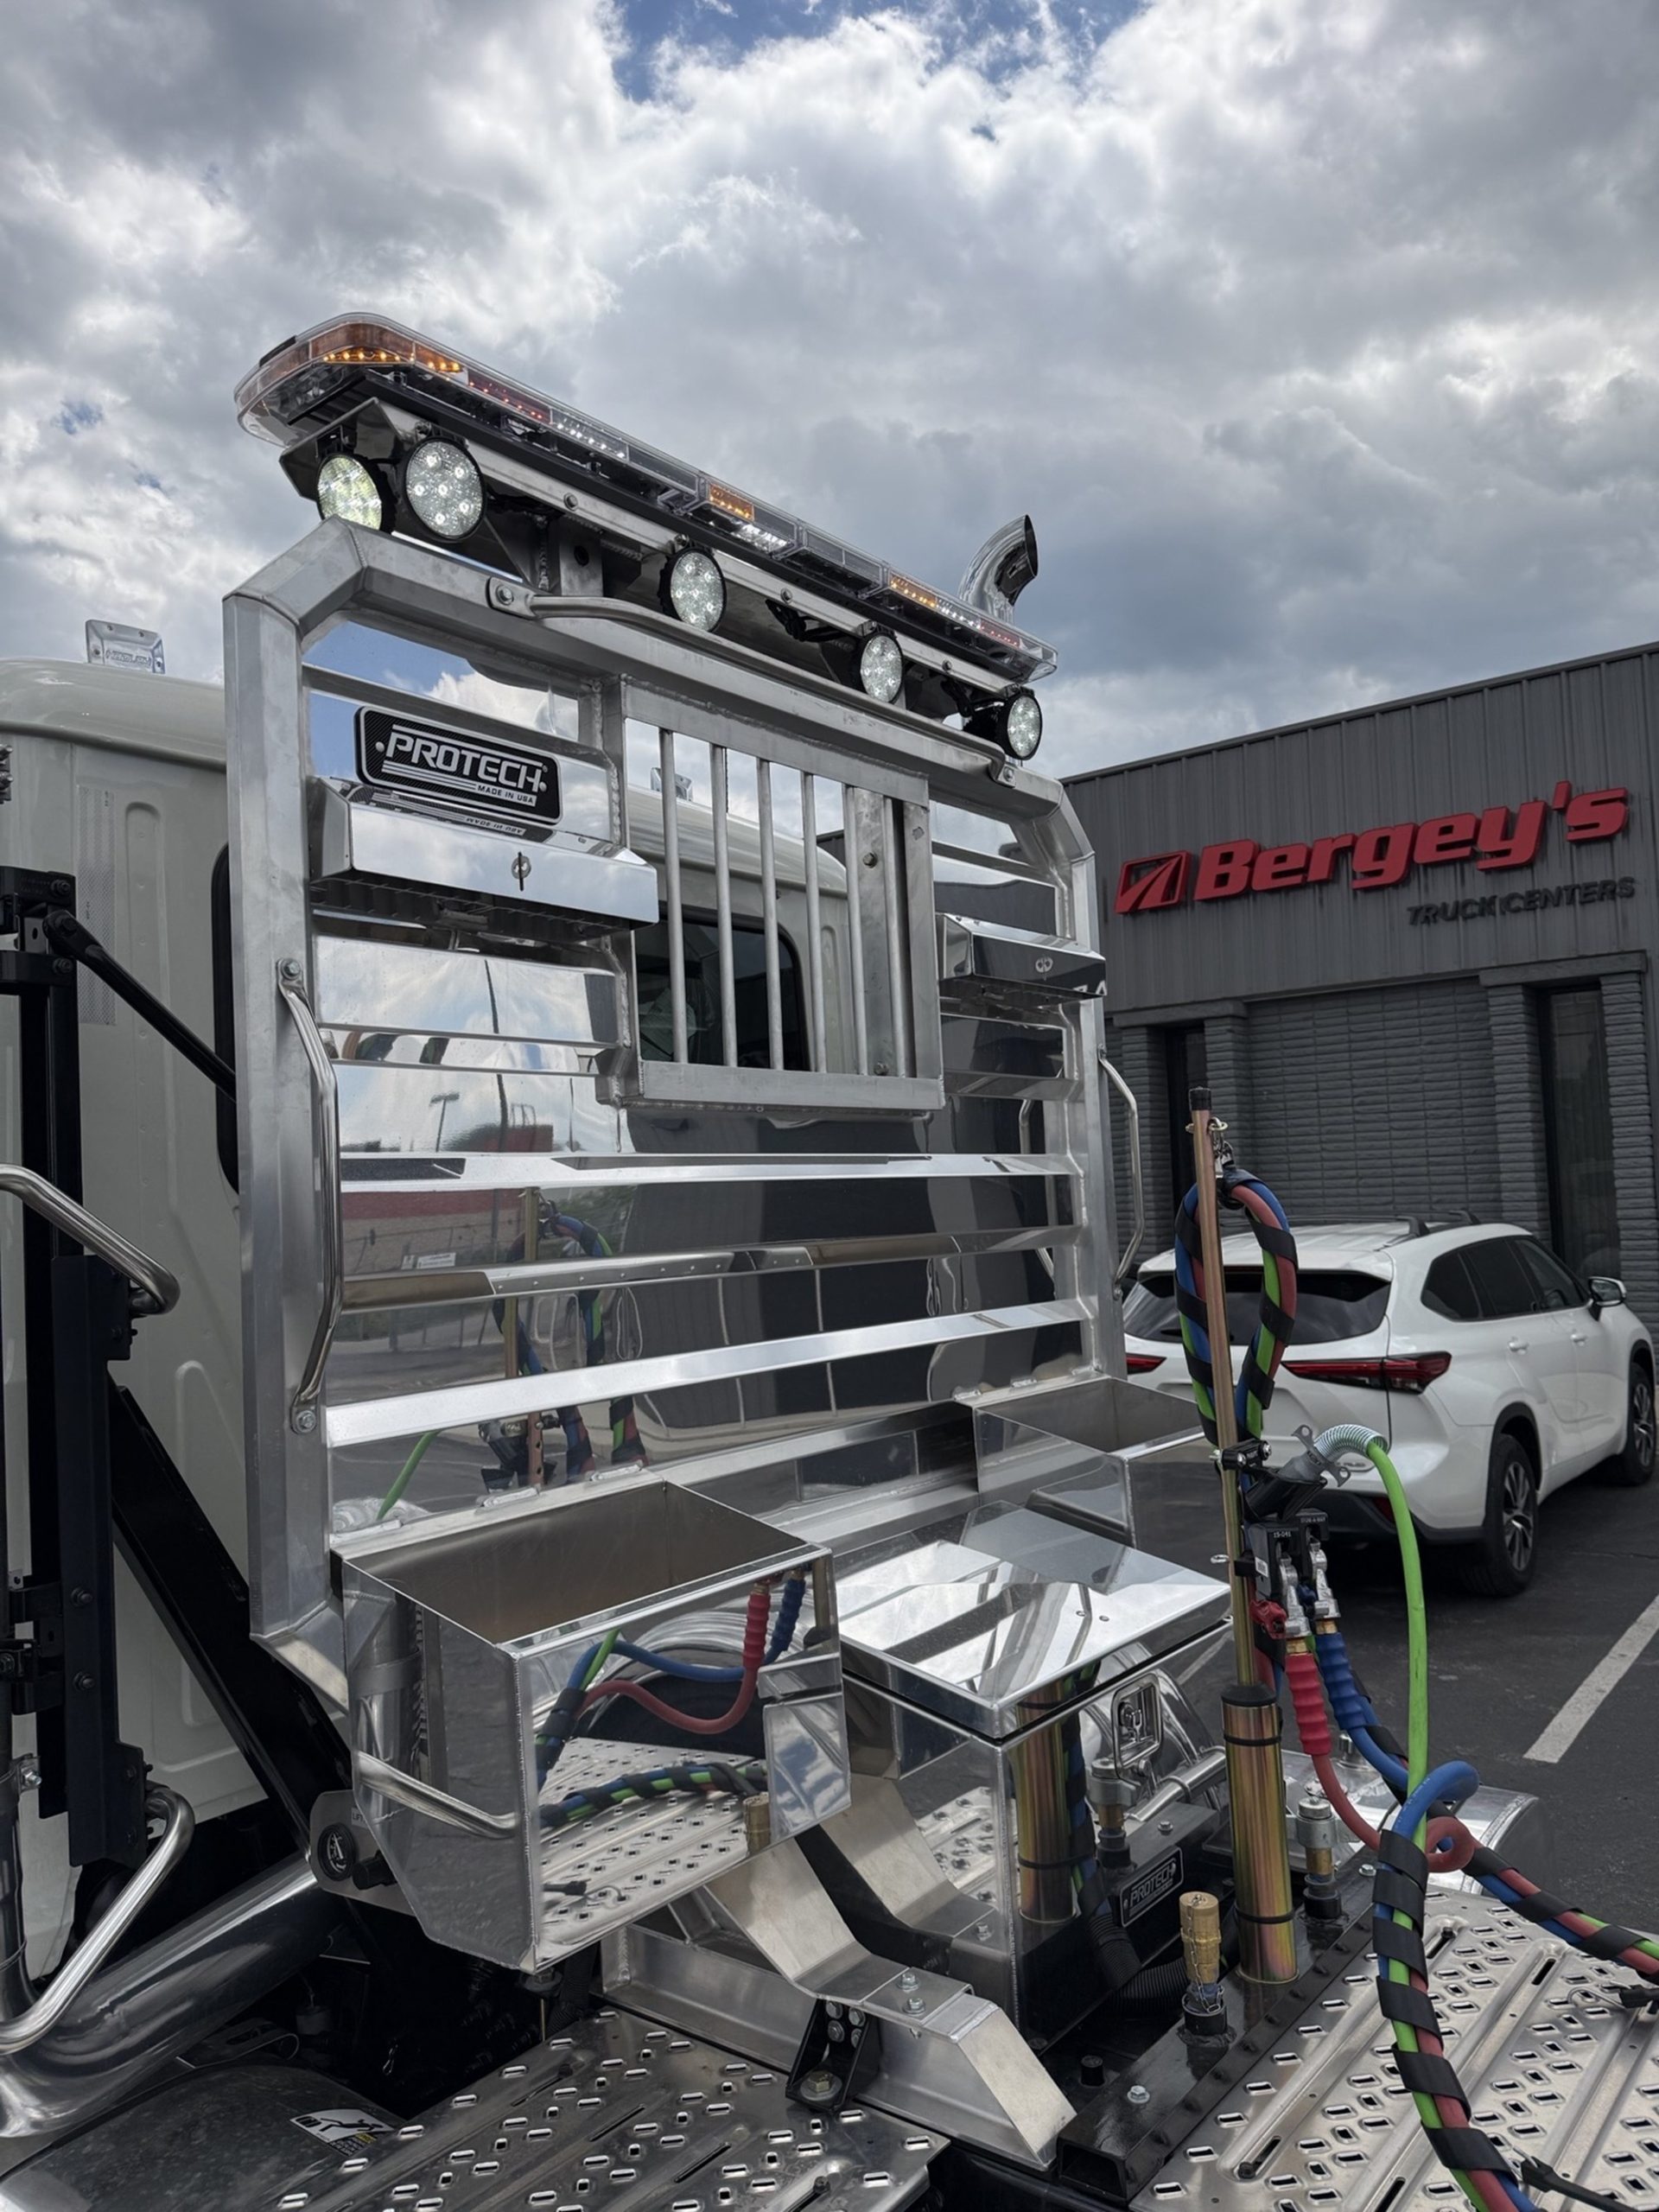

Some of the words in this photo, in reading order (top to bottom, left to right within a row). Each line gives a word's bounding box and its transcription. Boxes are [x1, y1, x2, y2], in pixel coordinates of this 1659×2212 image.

[385, 732, 543, 793] PROTECH
[477, 785, 502, 796] MADE
[517, 794, 533, 804] USA
[1193, 781, 1630, 901] Bergey's
[1407, 894, 1497, 926] TRUCK
[1500, 876, 1636, 918] CENTERS
[1130, 1861, 1176, 1908] PROTECH
